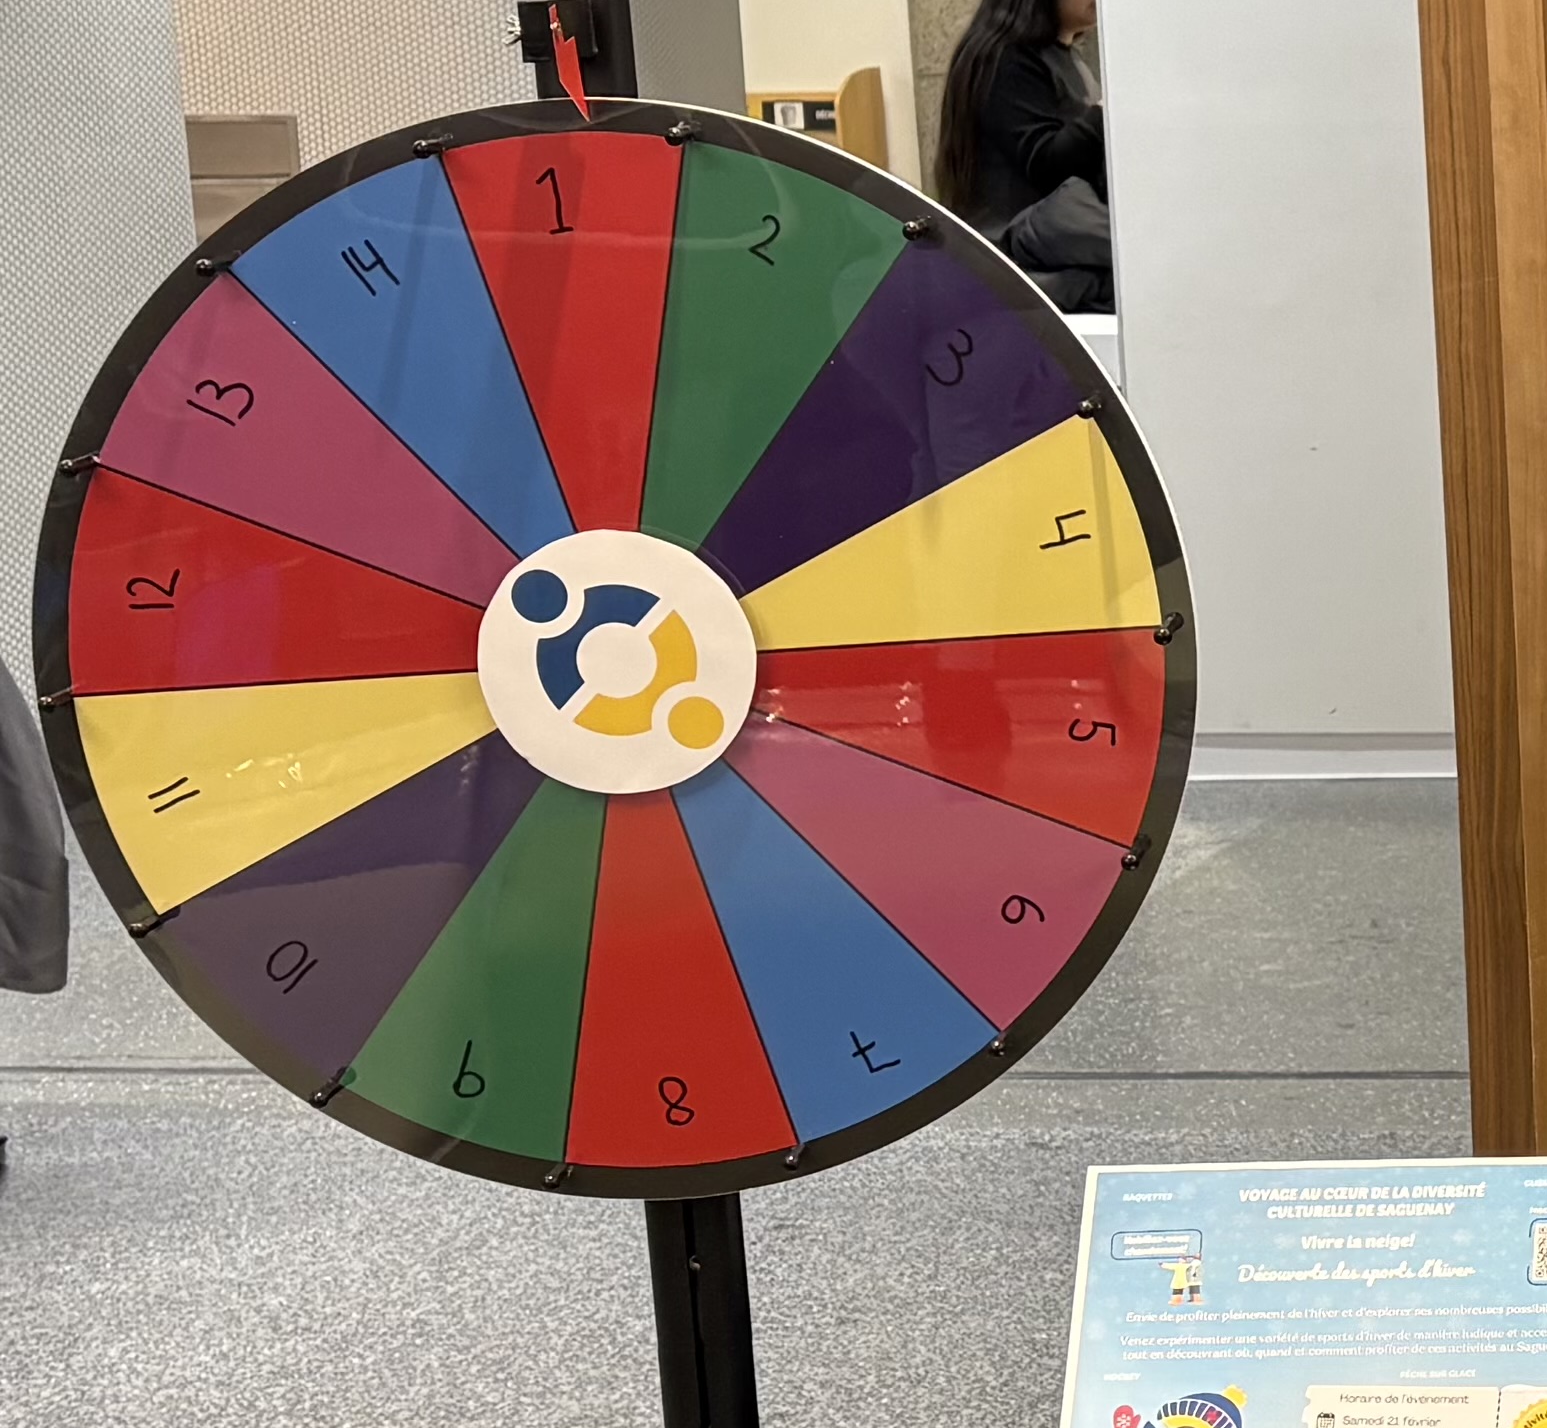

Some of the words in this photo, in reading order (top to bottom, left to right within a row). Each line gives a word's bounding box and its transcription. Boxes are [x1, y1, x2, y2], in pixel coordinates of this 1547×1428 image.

[535, 167, 574, 236] 1
[747, 216, 781, 265] 2
[339, 238, 400, 297] 14
[926, 328, 975, 389] 3
[186, 377, 256, 426] 13
[1040, 509, 1087, 555] 4
[129, 566, 180, 612] 12
[1069, 719, 1116, 746] 5
[146, 778, 201, 814] 11
[266, 939, 317, 993] 10
[851, 1031, 900, 1076] 7
[657, 1075, 695, 1126] 8
[1239, 1188, 1299, 1202] VOYAGE
[1300, 1187, 1322, 1201] AU
[1323, 1186, 1369, 1200] CŒUR
[1370, 1186, 1390, 1199] DE
[1392, 1186, 1410, 1199] LA
[1412, 1181, 1487, 1199] DIVERSITÉ
[1267, 1204, 1354, 1219] CULTURELLE
[1355, 1203, 1375, 1217] DE
[1376, 1202, 1455, 1217] SAGUENAY
[1301, 1235, 1345, 1250] Vivre
[1346, 1234, 1362, 1249] la
[1365, 1233, 1416, 1251] neige!
[1238, 1262, 1330, 1283] Découverte
[1331, 1260, 1361, 1280] des
[1360, 1260, 1417, 1288] sports
[1159, 1310, 1174, 1322] de
[1175, 1310, 1220, 1324] profiter
[1120, 1335, 1155, 1347] Venez
[1339, 1393, 1382, 1404] Horaire
[1384, 1394, 1399, 1404] de
[1342, 1415, 1384, 1426] Samedi
[1387, 1416, 1400, 1426] 21
